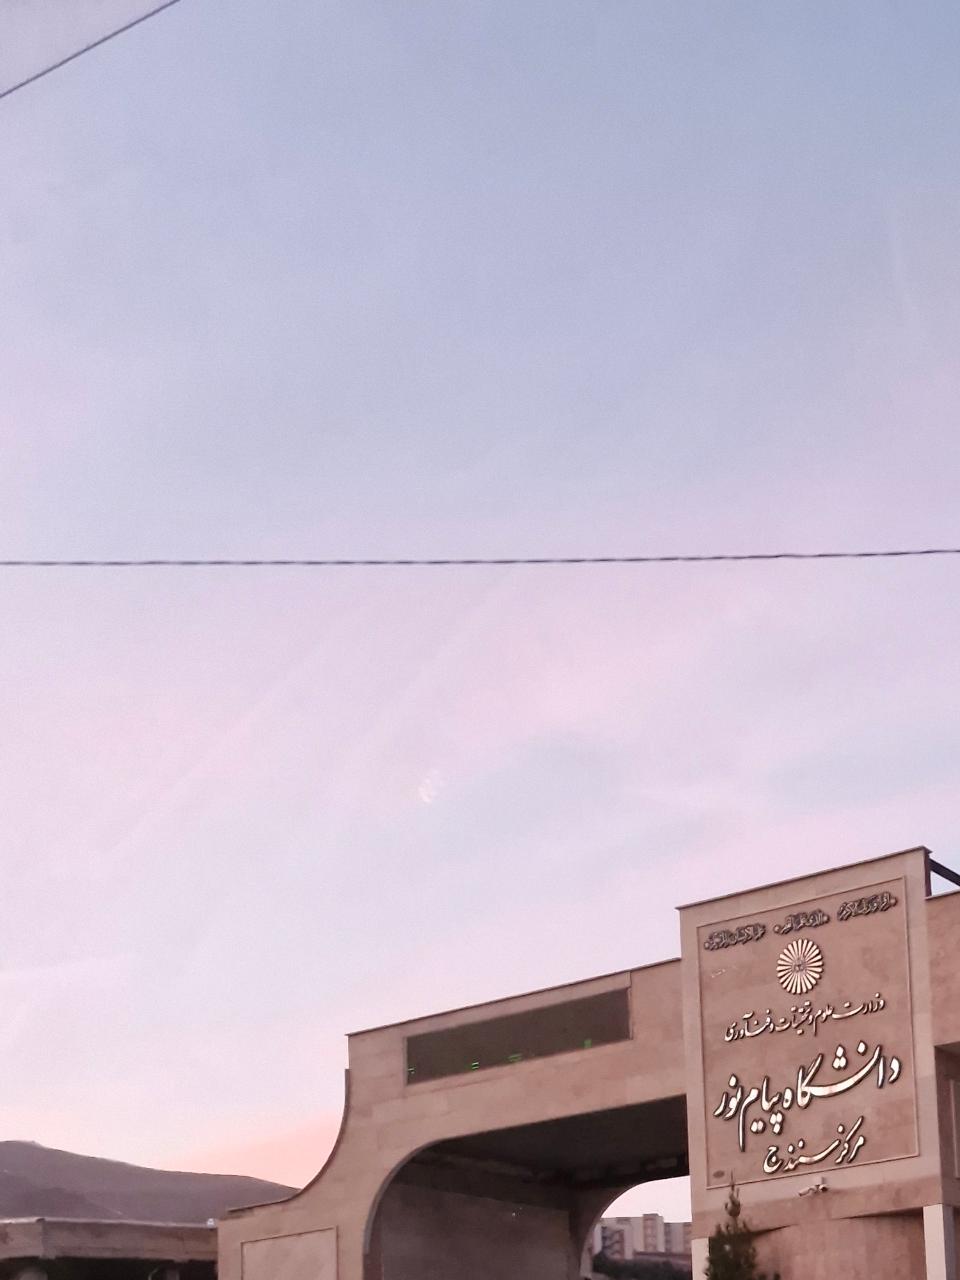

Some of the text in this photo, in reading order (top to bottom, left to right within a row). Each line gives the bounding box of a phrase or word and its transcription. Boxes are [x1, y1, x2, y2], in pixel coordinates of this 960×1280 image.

[813, 1004, 834, 1036] علوم
[832, 993, 885, 1019] وزارت
[713, 1040, 901, 1152] دانشگاه پیام نور
[763, 1115, 866, 1174] مرکز سنندج
